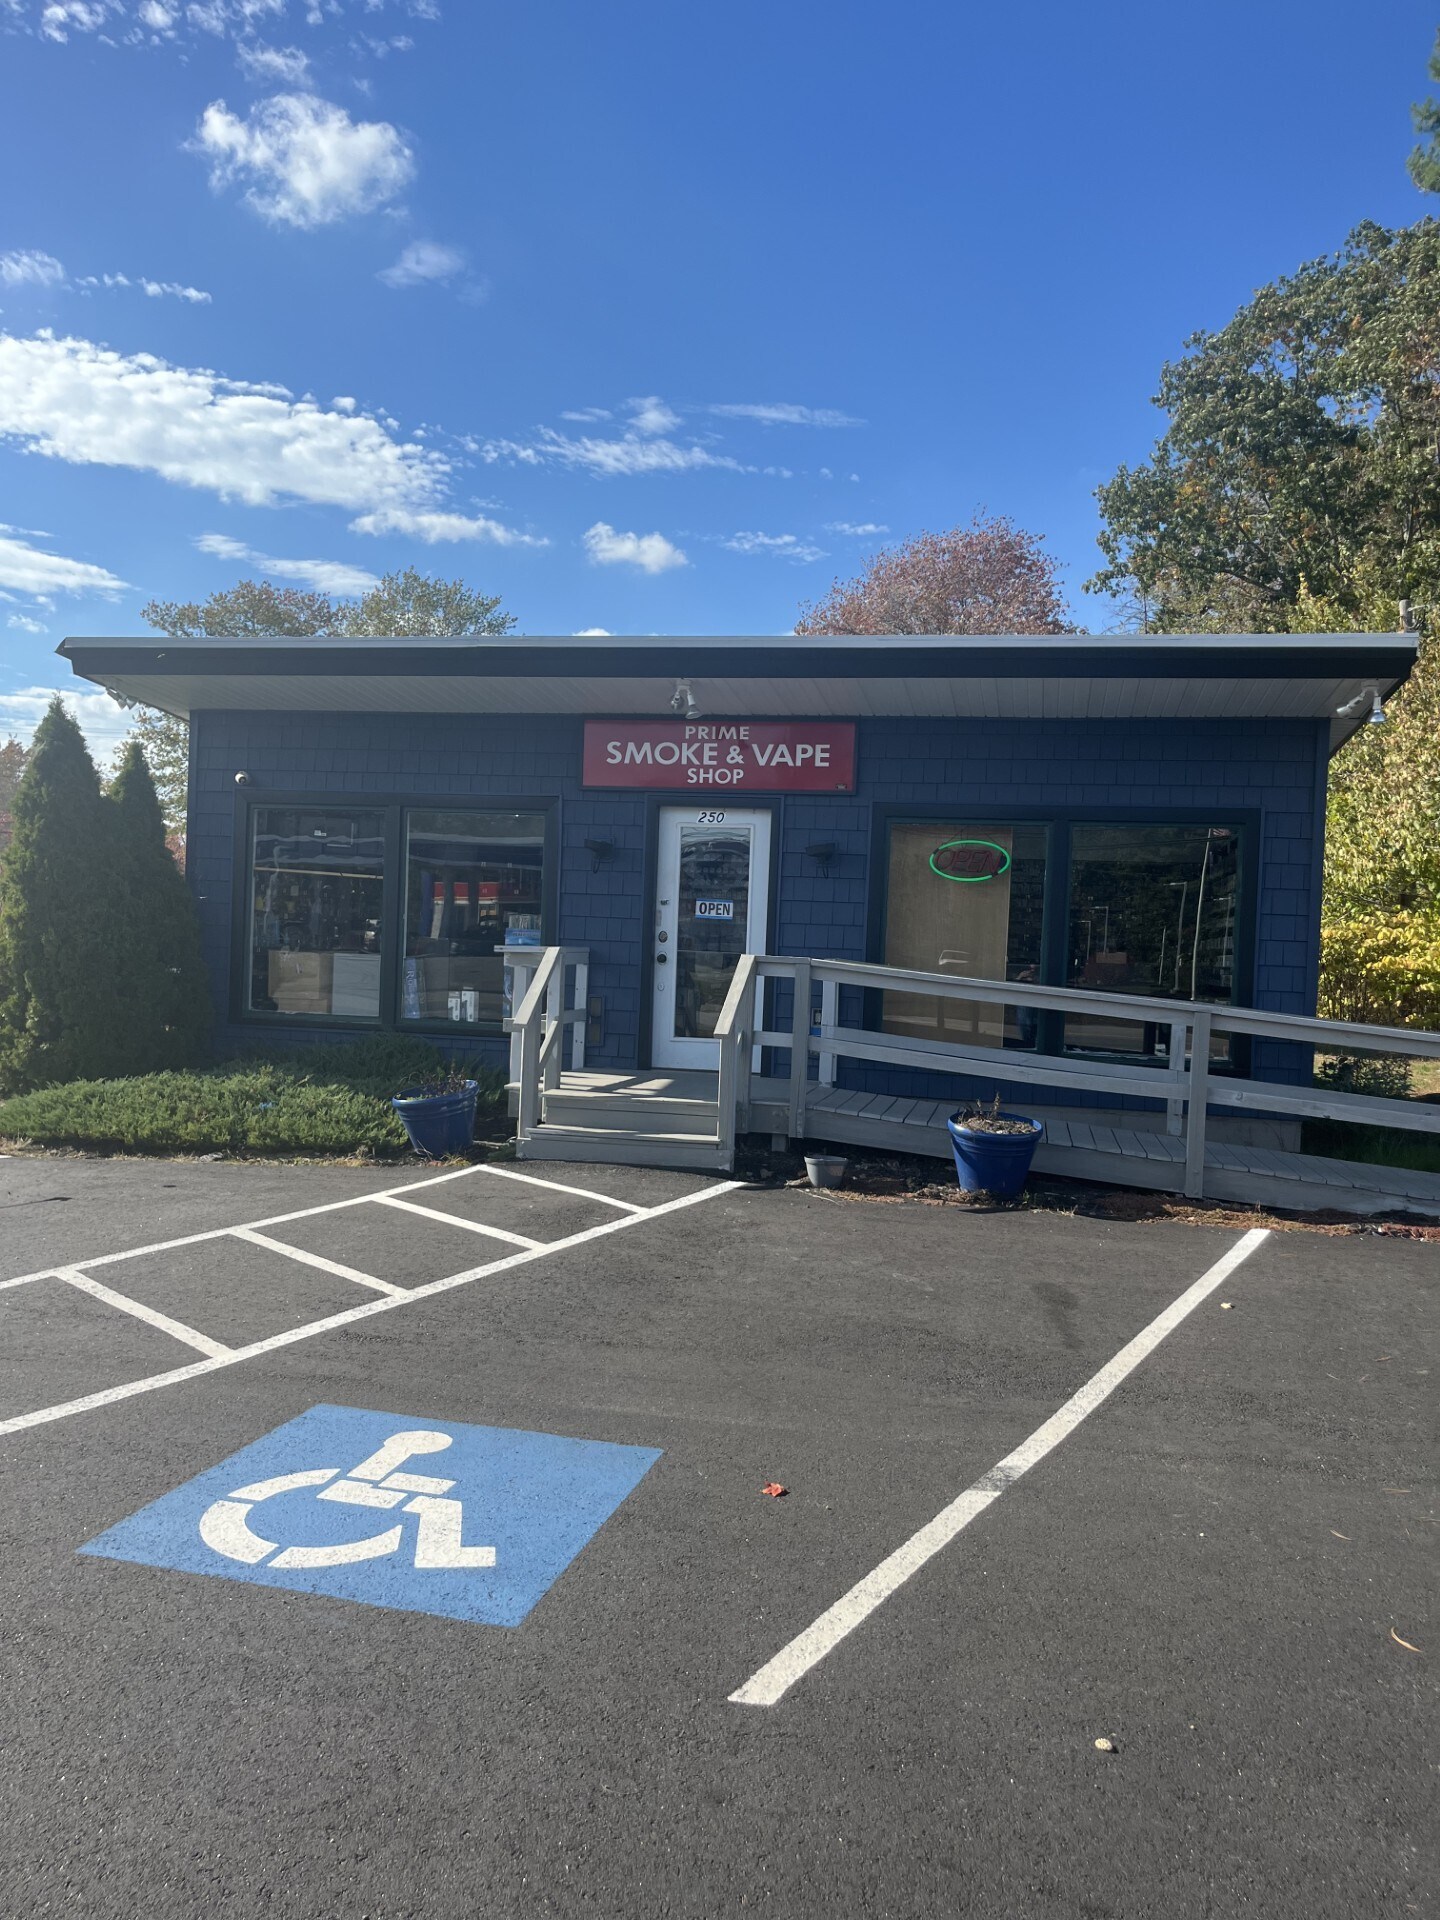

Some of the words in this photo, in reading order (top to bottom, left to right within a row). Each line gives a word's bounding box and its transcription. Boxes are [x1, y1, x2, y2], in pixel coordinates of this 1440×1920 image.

[685, 725, 750, 740] PRIME
[606, 741, 718, 766] SMOKE
[726, 745, 744, 765] &
[751, 743, 831, 768] VAPE
[687, 768, 744, 785] SHOP
[697, 811, 725, 824] 250
[934, 848, 1003, 873] OPEN
[698, 902, 731, 916] OPEN
